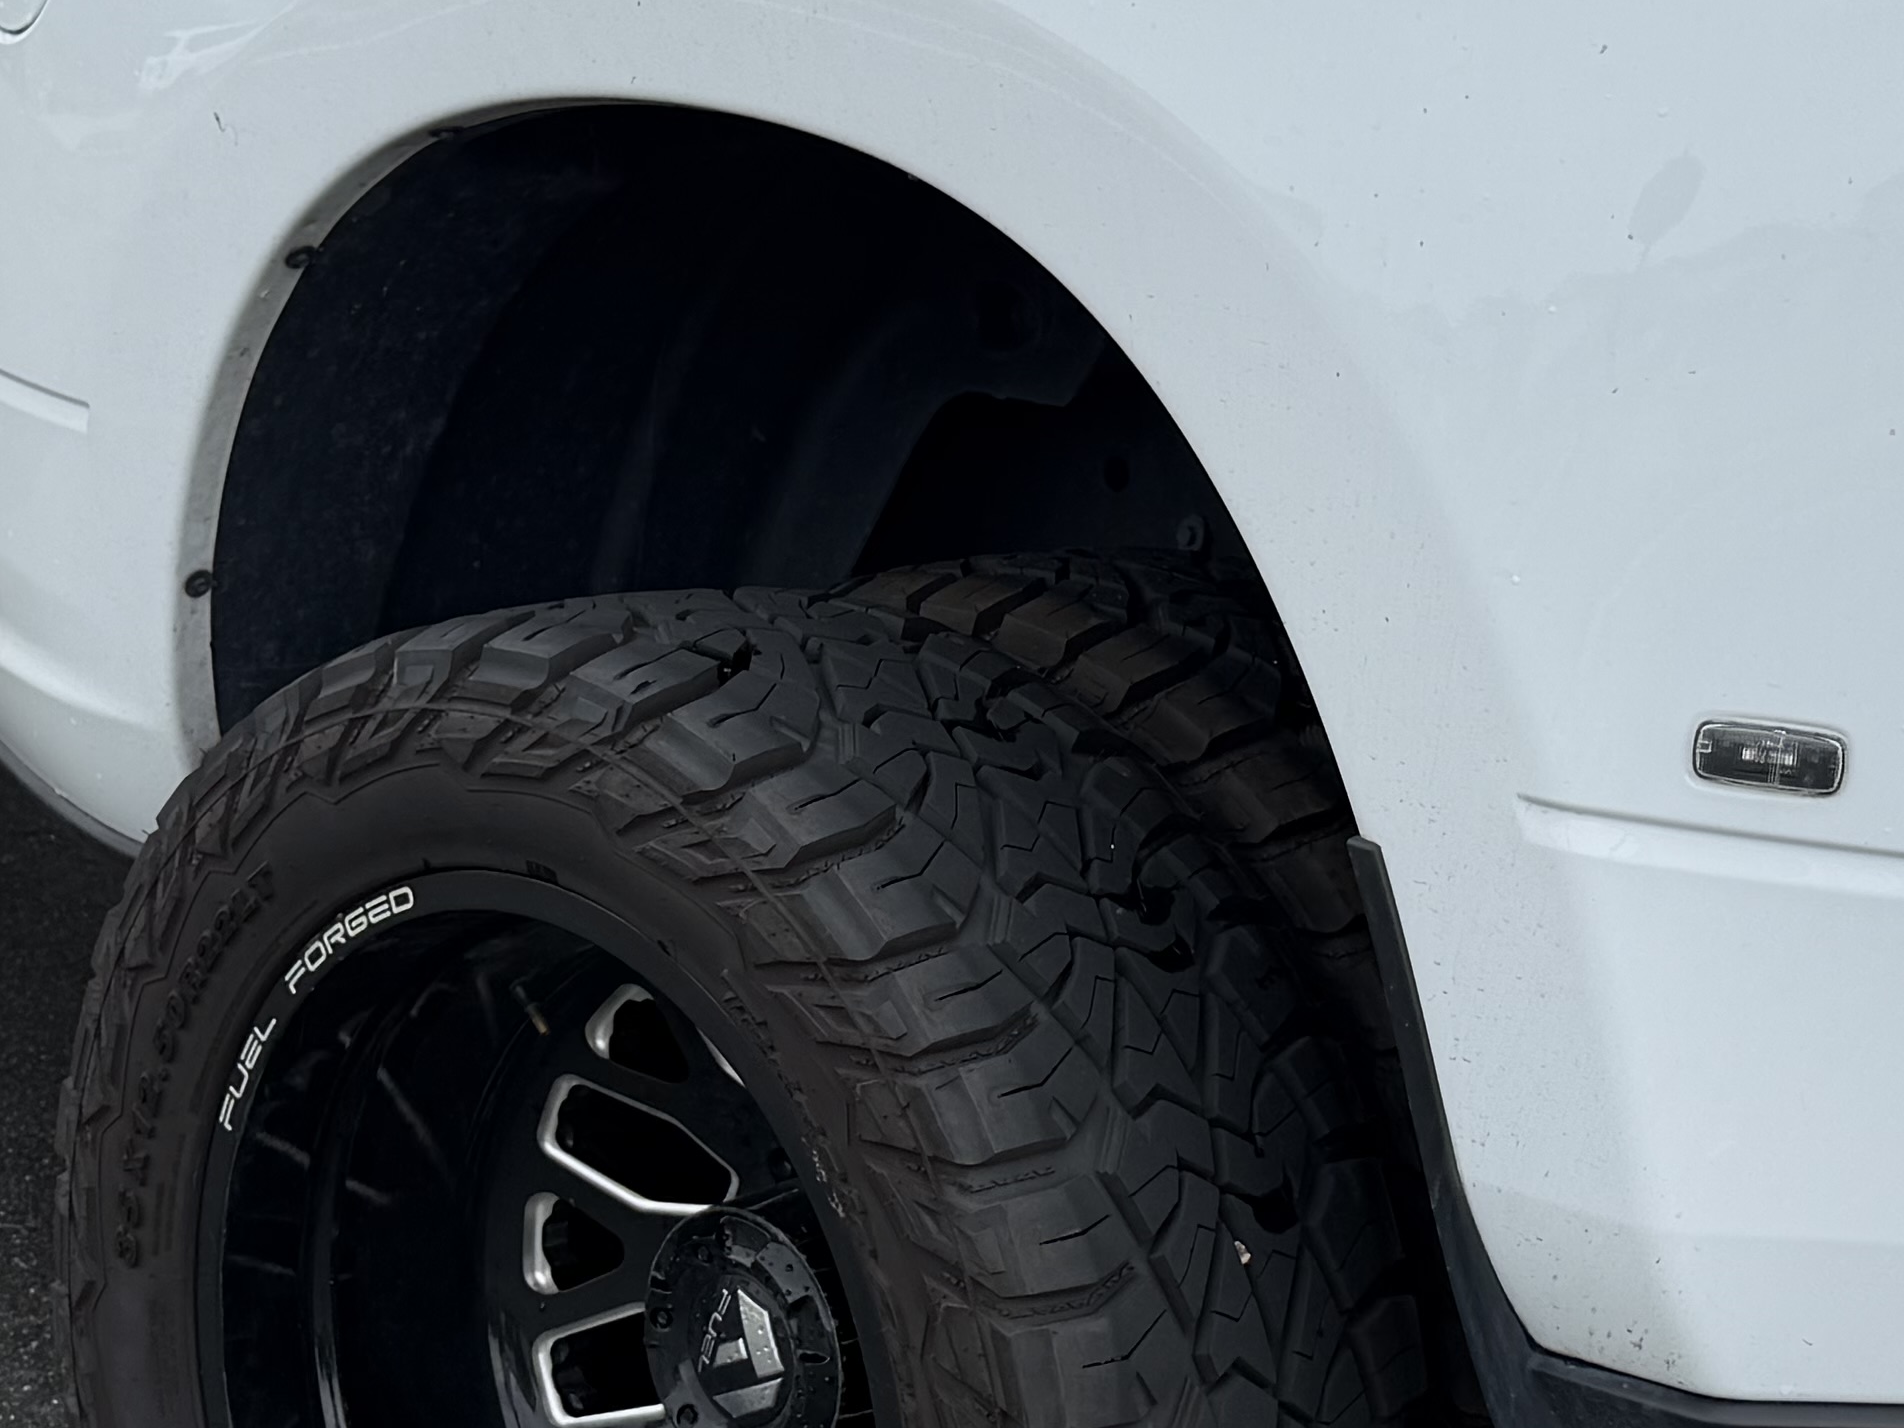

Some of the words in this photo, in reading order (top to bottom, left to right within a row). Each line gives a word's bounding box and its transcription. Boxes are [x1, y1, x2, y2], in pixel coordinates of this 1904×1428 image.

[218, 1016, 277, 1132] FUEL
[284, 884, 415, 995] FORGED
[698, 1288, 732, 1373] FUEL
